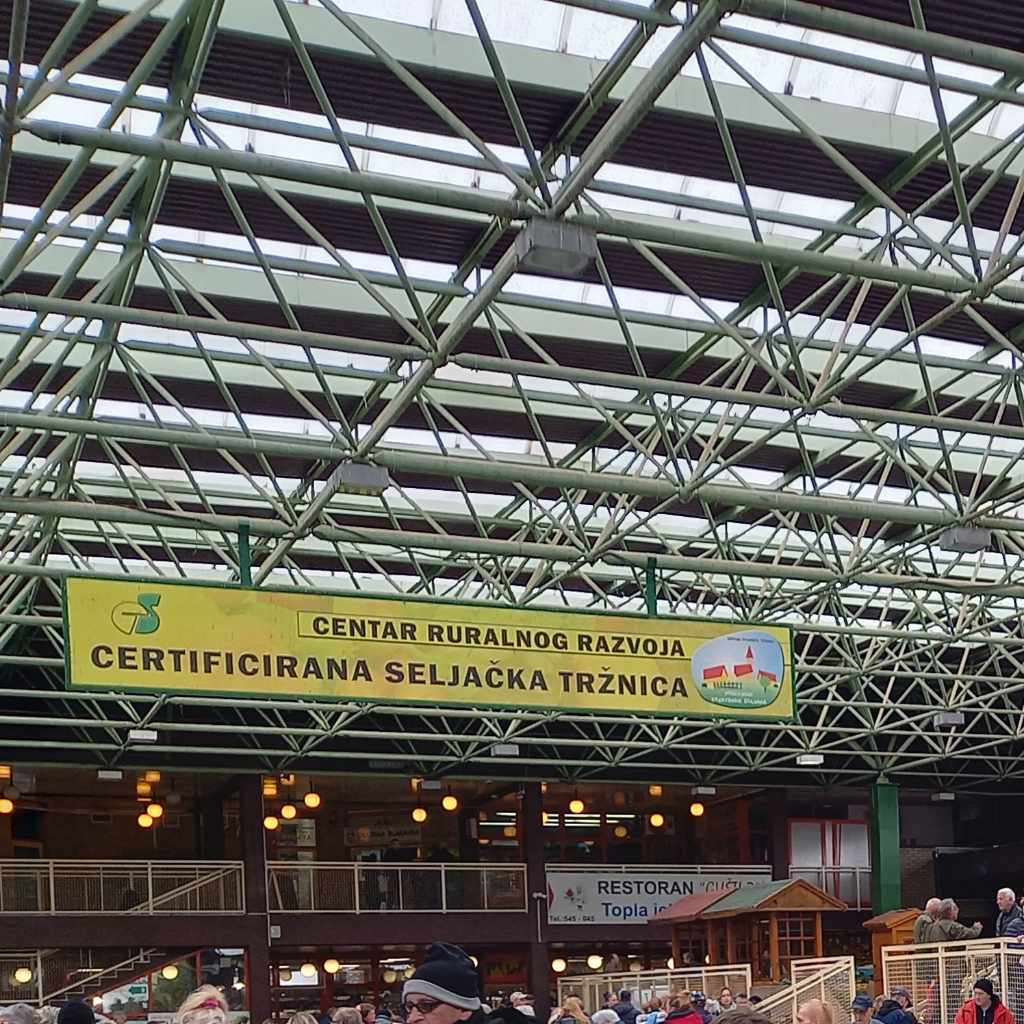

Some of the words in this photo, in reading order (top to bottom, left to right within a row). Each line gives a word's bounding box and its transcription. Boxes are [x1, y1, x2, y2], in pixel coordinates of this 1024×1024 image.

[312, 615, 417, 641] CENTAR
[427, 624, 568, 651] RURALNOG
[578, 634, 686, 657] RAZVOJA
[90, 644, 373, 683] CERTIFICIRANA
[384, 659, 548, 691] SELJAČKA
[558, 666, 689, 698] TRŽNICA
[598, 880, 694, 896] RESTORAN
[601, 902, 649, 920] Topla
